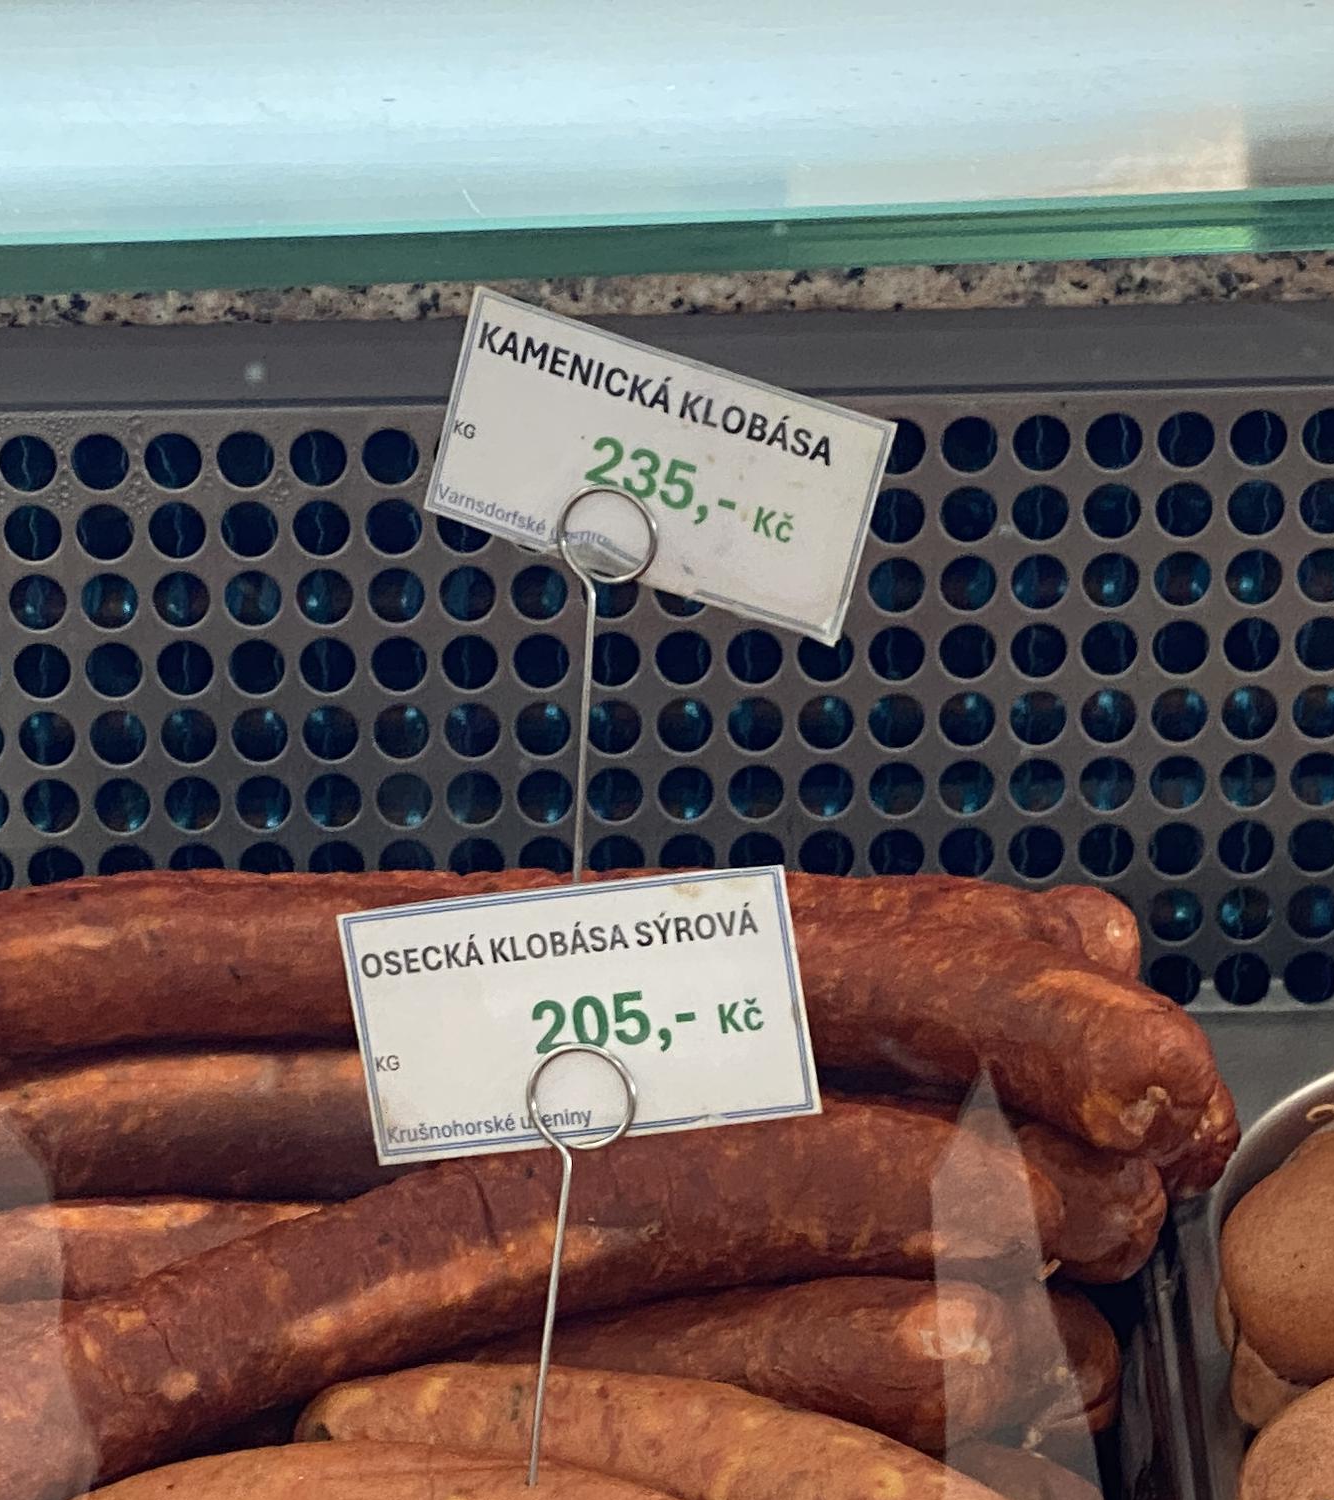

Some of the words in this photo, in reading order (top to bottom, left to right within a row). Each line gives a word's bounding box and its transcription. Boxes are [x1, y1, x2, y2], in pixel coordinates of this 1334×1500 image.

[478, 321, 671, 415] KAMENICKÁ
[679, 391, 832, 467] KLOBÁSA
[453, 419, 477, 441] KG
[436, 483, 546, 536] Varnsdorfské
[584, 436, 736, 525] 235,-
[753, 505, 796, 545] Kč
[361, 933, 483, 980] OSECKÁ
[491, 921, 629, 965] KLOBÁSA
[635, 902, 759, 948] SÝROVÁ
[530, 989, 697, 1055] 205,-
[718, 998, 766, 1034] Kč
[375, 1053, 401, 1073] KG
[386, 1110, 515, 1145] Krušnohorské
[521, 1106, 592, 1131] ueniny
